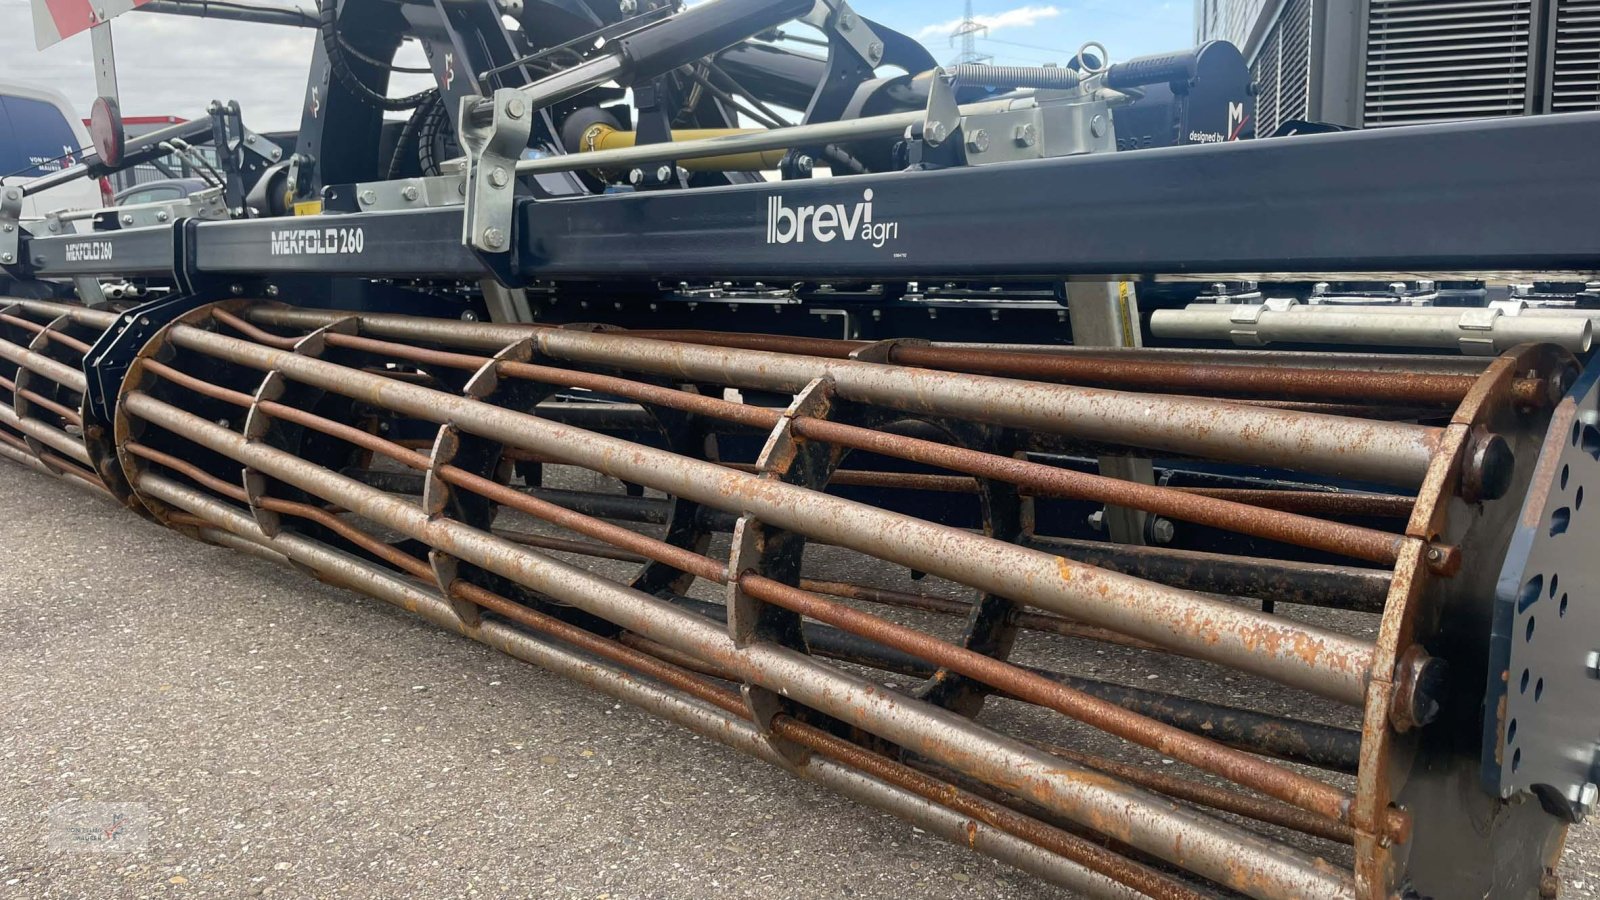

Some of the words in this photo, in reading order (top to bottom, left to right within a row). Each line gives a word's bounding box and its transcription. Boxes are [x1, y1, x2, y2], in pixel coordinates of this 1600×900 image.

[1189, 130, 1216, 144] designed
[1216, 132, 1225, 143] by
[271, 228, 338, 255] MEKFOLD
[339, 227, 364, 254] 260
[861, 221, 898, 248] agri
[65, 242, 100, 261] MEKFOLD
[100, 241, 113, 260] 260
